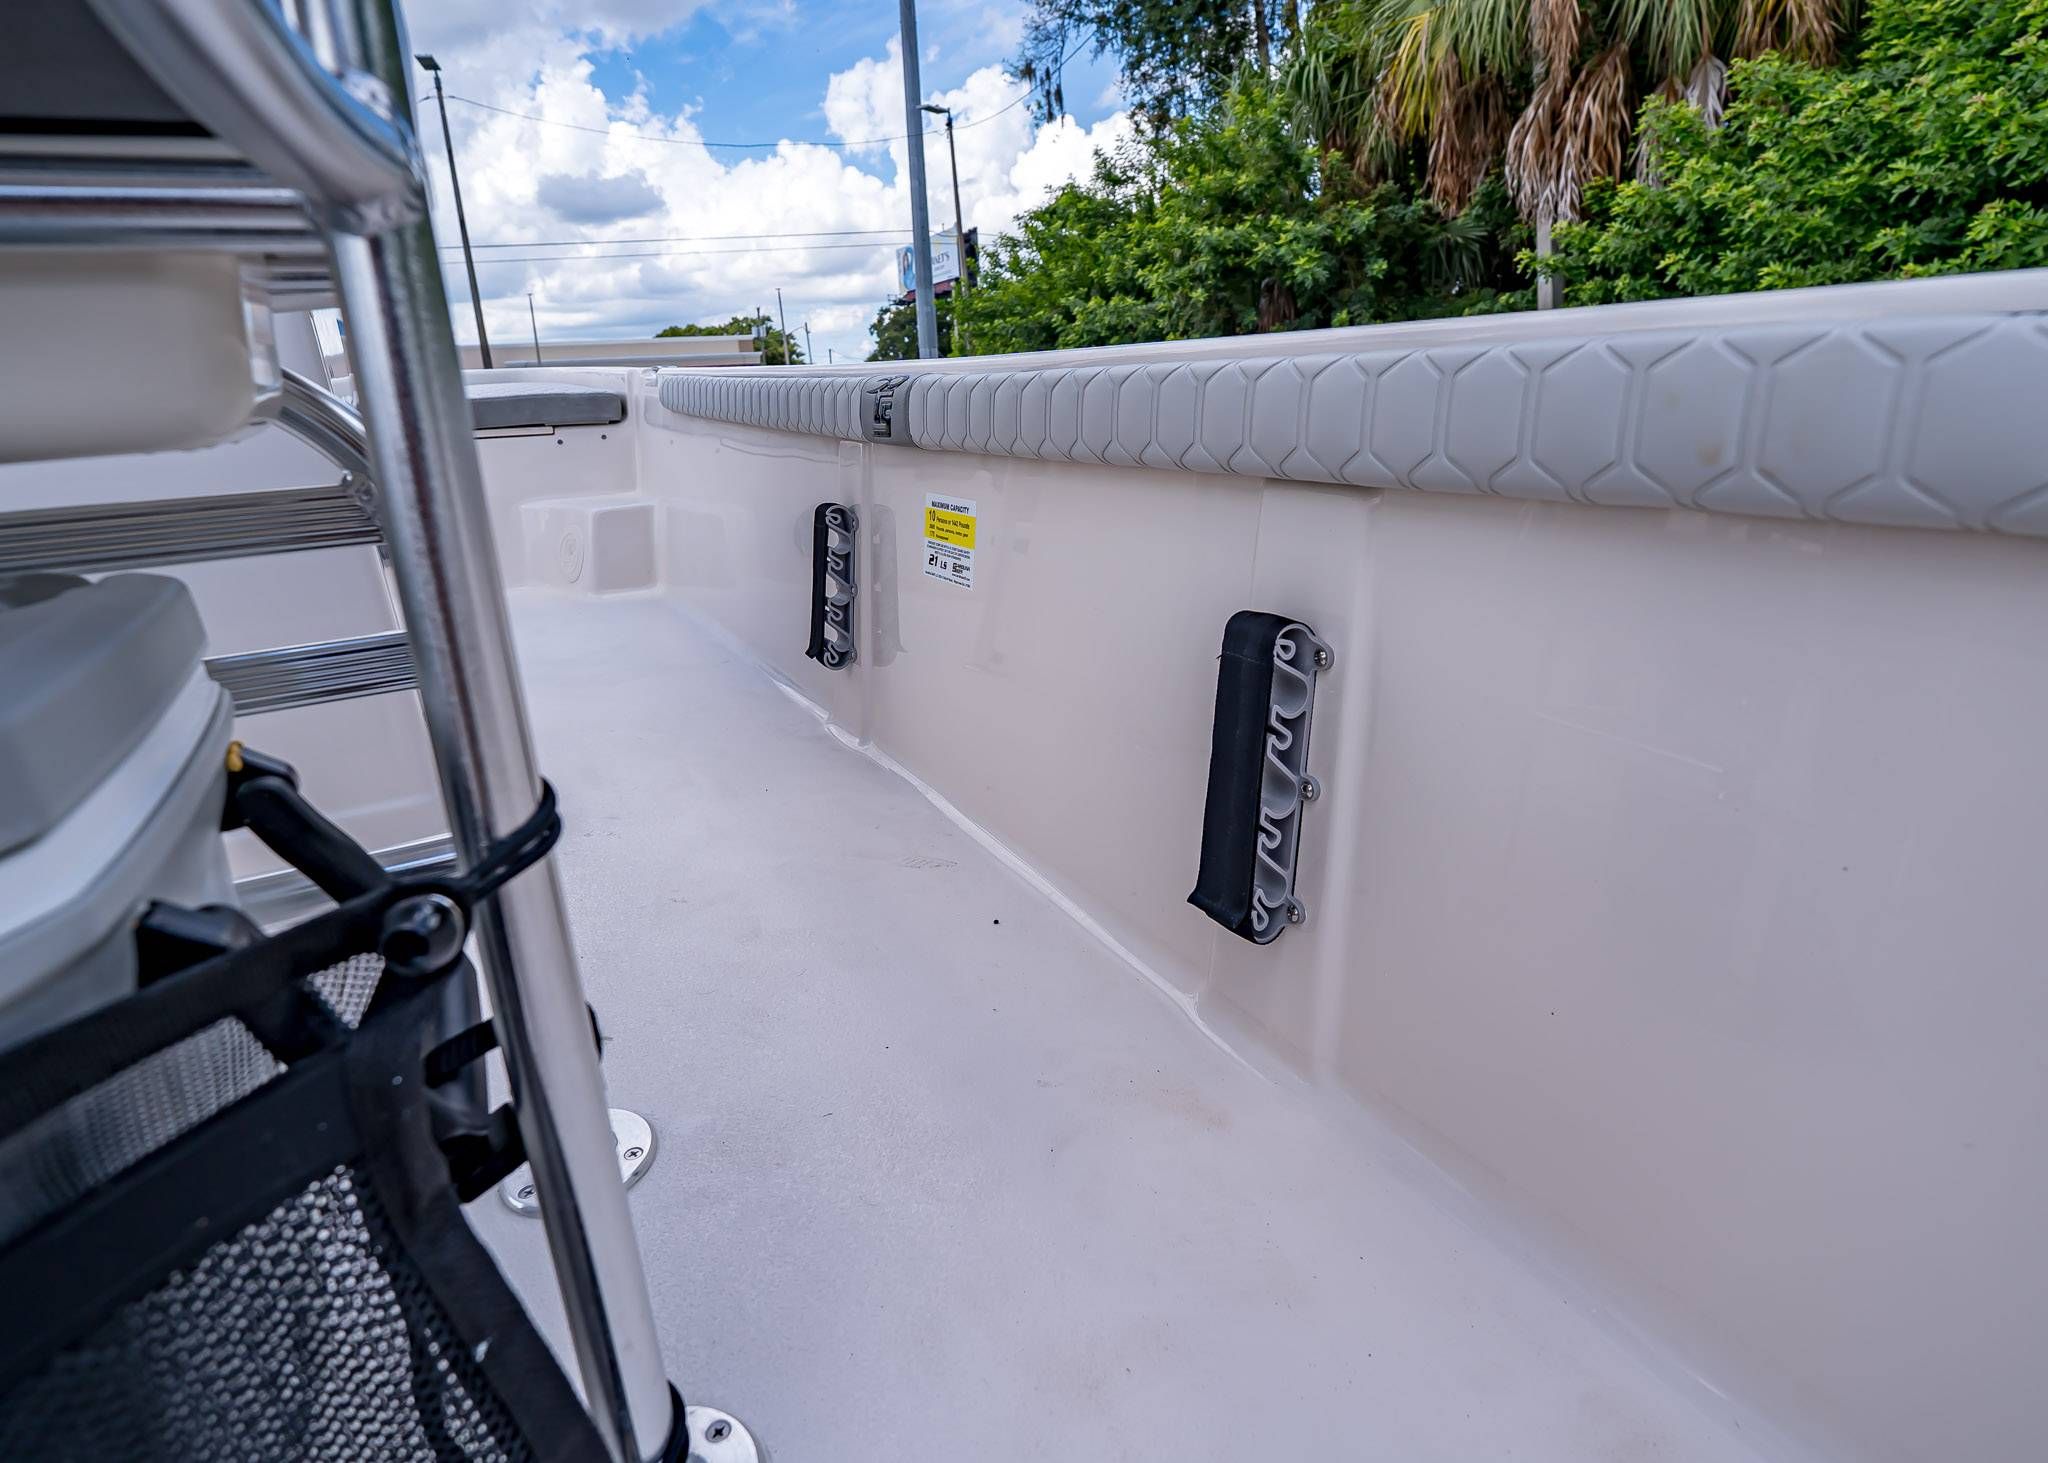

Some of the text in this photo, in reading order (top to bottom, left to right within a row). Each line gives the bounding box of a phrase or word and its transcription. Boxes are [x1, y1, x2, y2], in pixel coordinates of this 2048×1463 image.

[931, 500, 969, 514] MAXIMUM CAPACITY
[929, 510, 936, 521] 10
[928, 553, 938, 567] 21
[940, 560, 947, 570] LS
